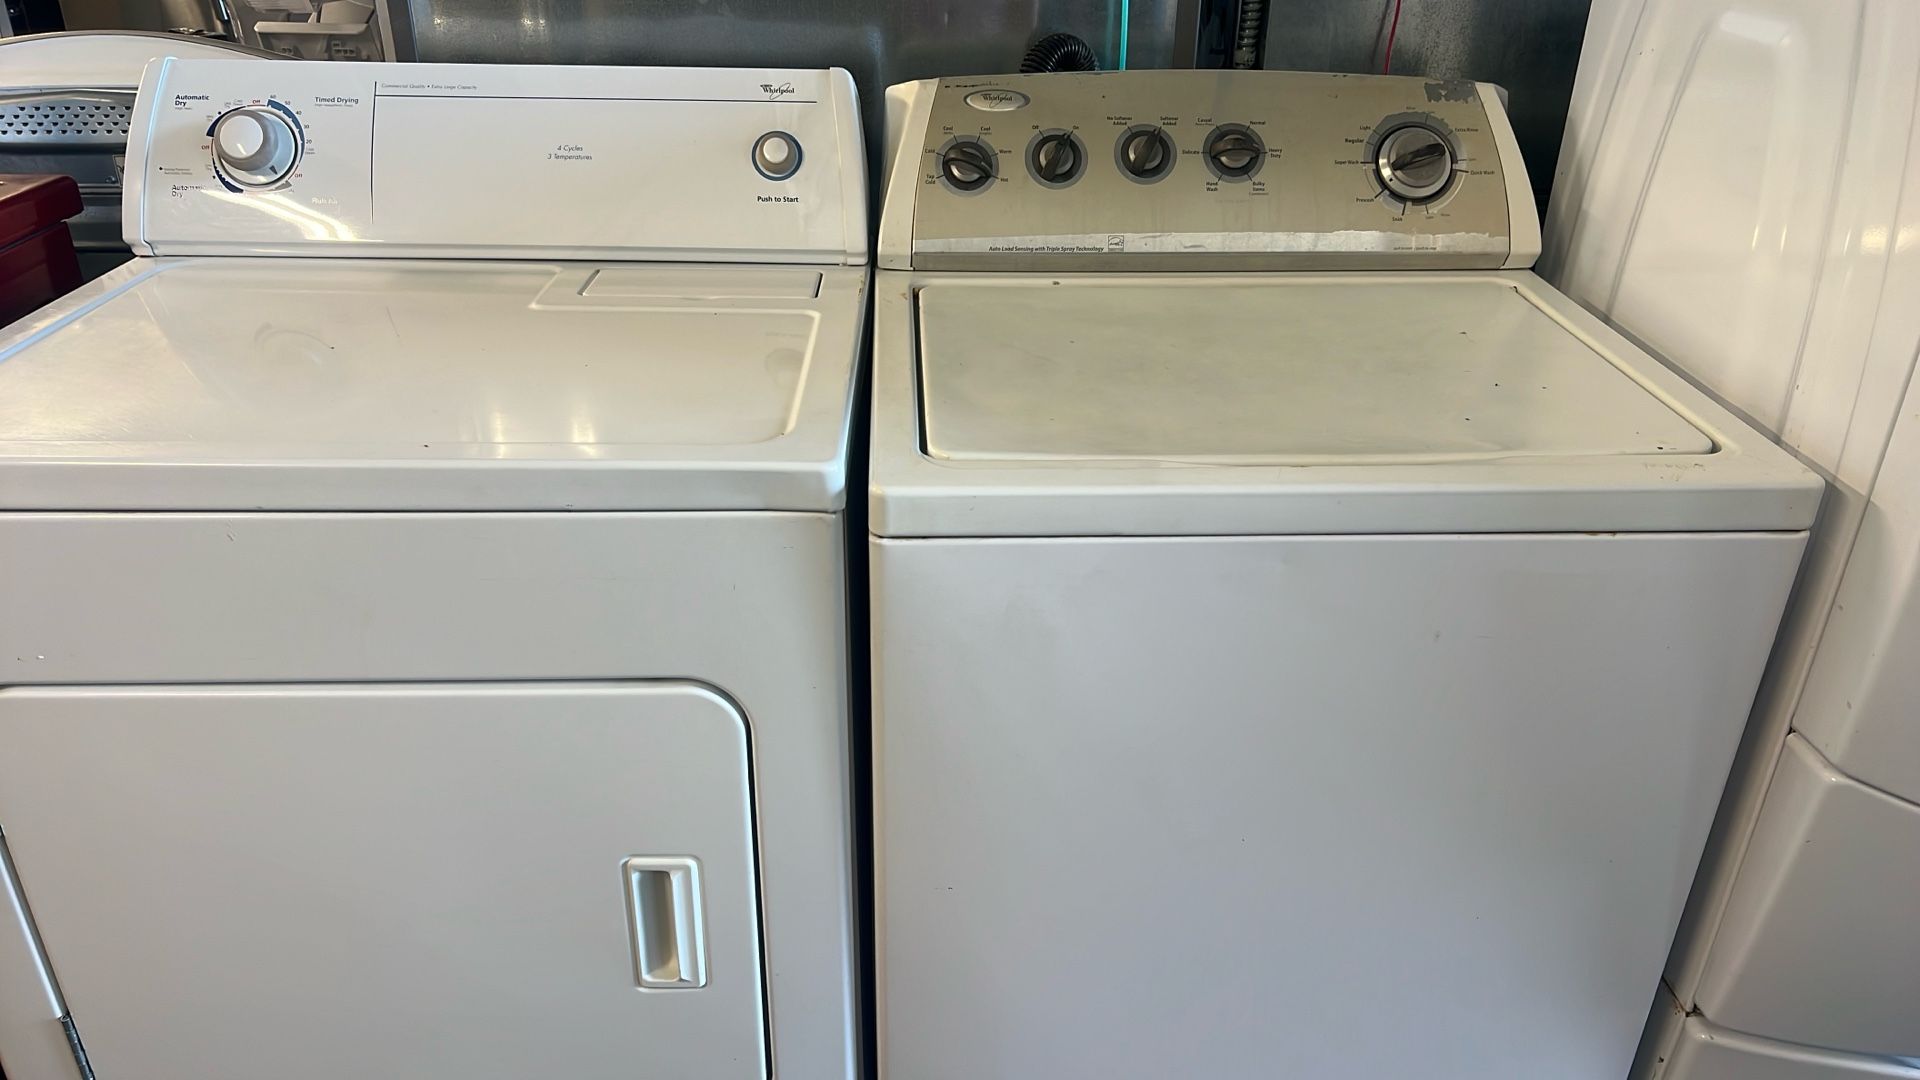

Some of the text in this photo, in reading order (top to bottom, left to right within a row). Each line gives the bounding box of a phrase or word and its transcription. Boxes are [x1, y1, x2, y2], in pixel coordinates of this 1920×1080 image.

[563, 144, 583, 153] Cycles
[554, 153, 593, 161] Temperatures
[757, 195, 773, 203] Push
[1046, 245, 1060, 253] Triple
